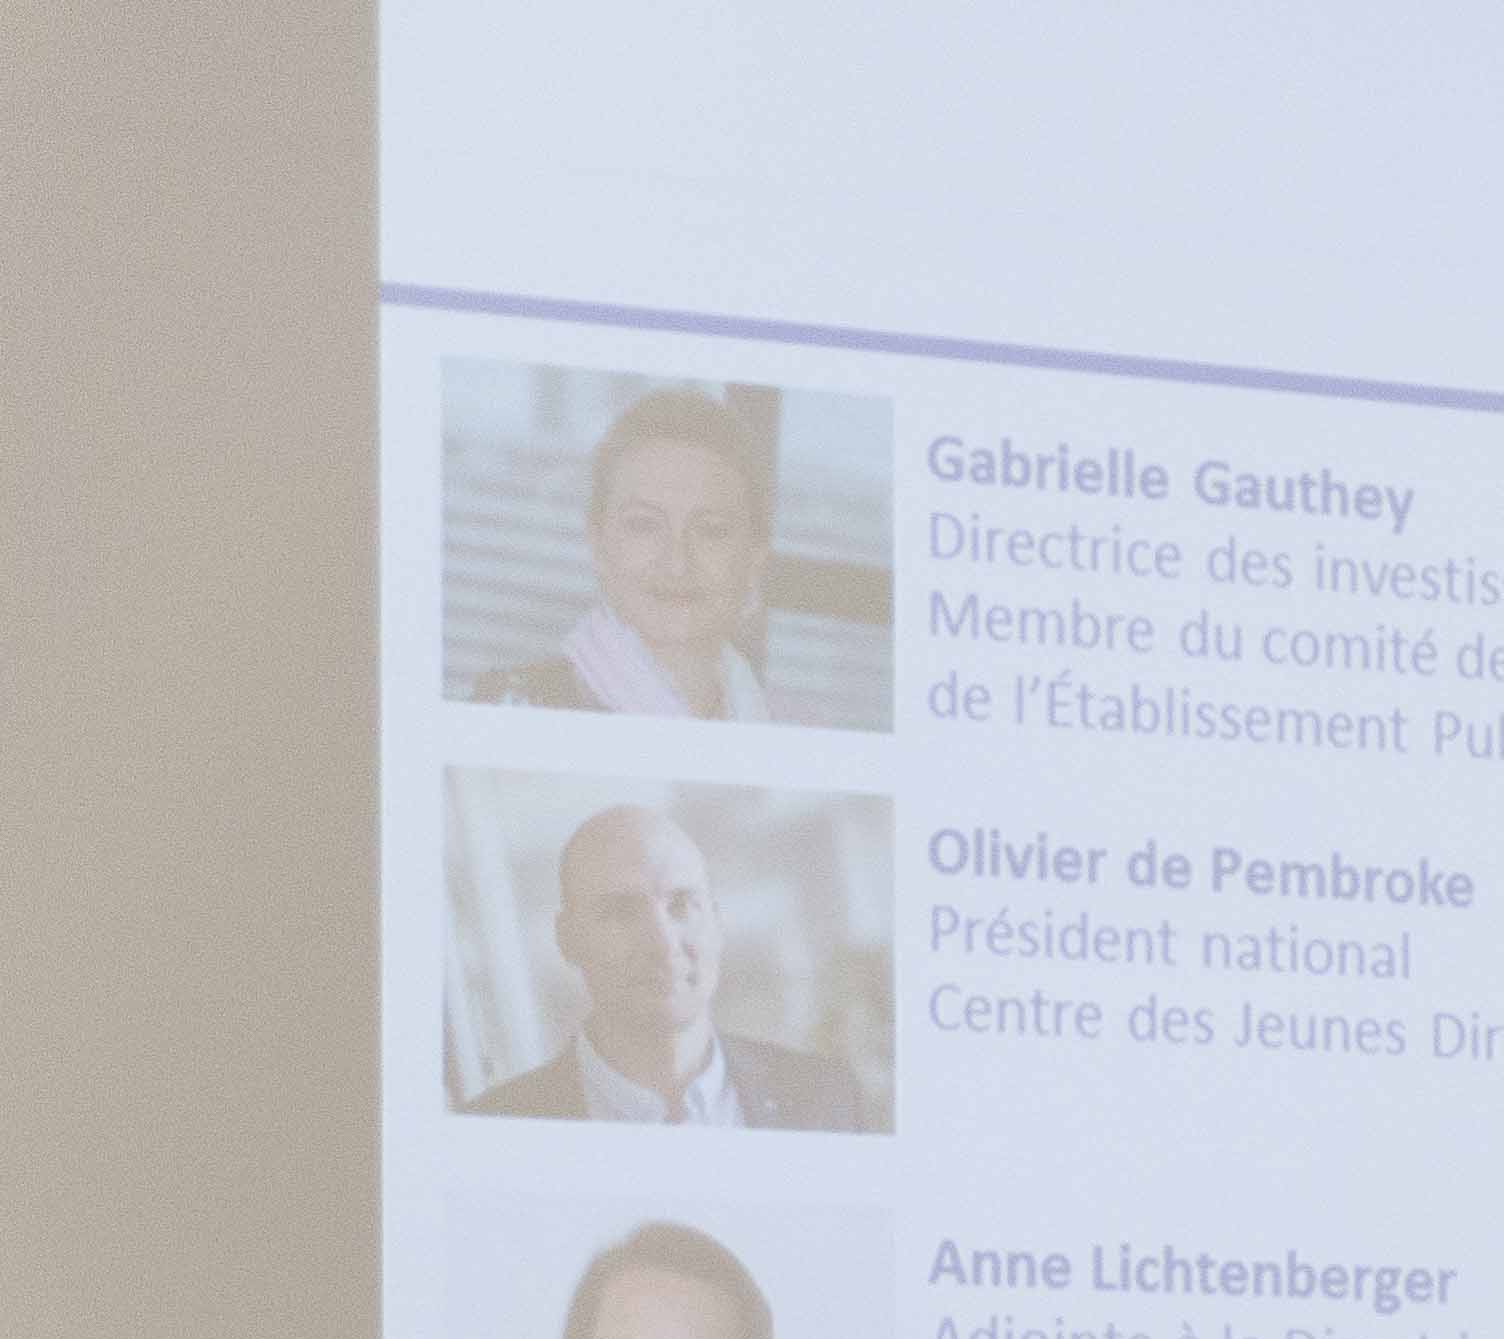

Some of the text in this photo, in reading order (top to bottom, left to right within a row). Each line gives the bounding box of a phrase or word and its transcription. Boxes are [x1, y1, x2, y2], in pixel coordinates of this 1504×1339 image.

[927, 435, 1414, 535] Gabrielle Gauthey
[929, 511, 1182, 579] Directrice
[1206, 535, 1293, 589] des
[929, 590, 1154, 653] Membre
[1179, 609, 1243, 661] du
[1261, 624, 1438, 677] comité
[927, 670, 991, 722] de
[928, 828, 1474, 908] Olivier de Pembroke
[930, 905, 1410, 979] Président national
[928, 983, 1103, 1039] Centre
[1127, 994, 1214, 1045] des
[1235, 1001, 1406, 1056] Jeunes
[929, 1239, 1457, 1316] Anne Lichtenberger
